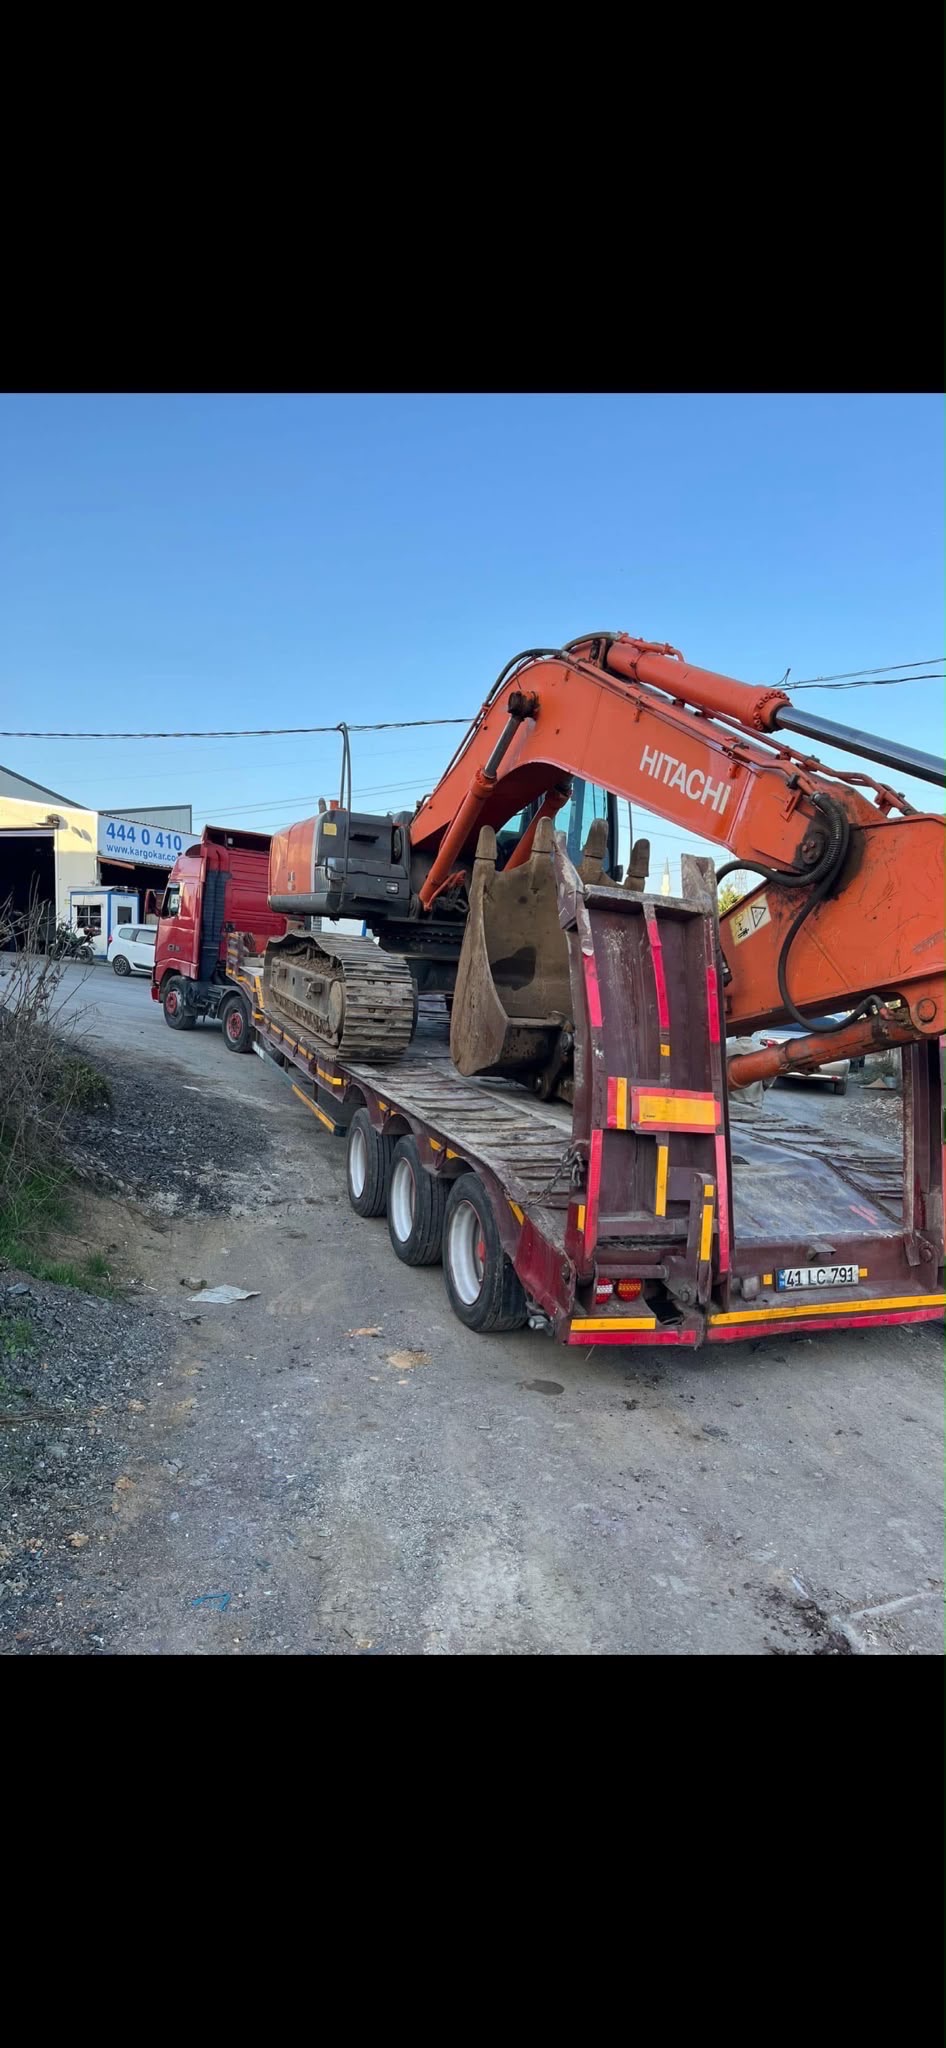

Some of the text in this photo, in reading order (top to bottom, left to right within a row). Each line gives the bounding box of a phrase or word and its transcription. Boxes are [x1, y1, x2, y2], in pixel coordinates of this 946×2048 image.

[639, 744, 732, 815] HITACHI
[106, 822, 182, 851] 444 0 410
[106, 843, 176, 862] www.kargokar.co
[786, 1266, 854, 1287] 41 LC 791
